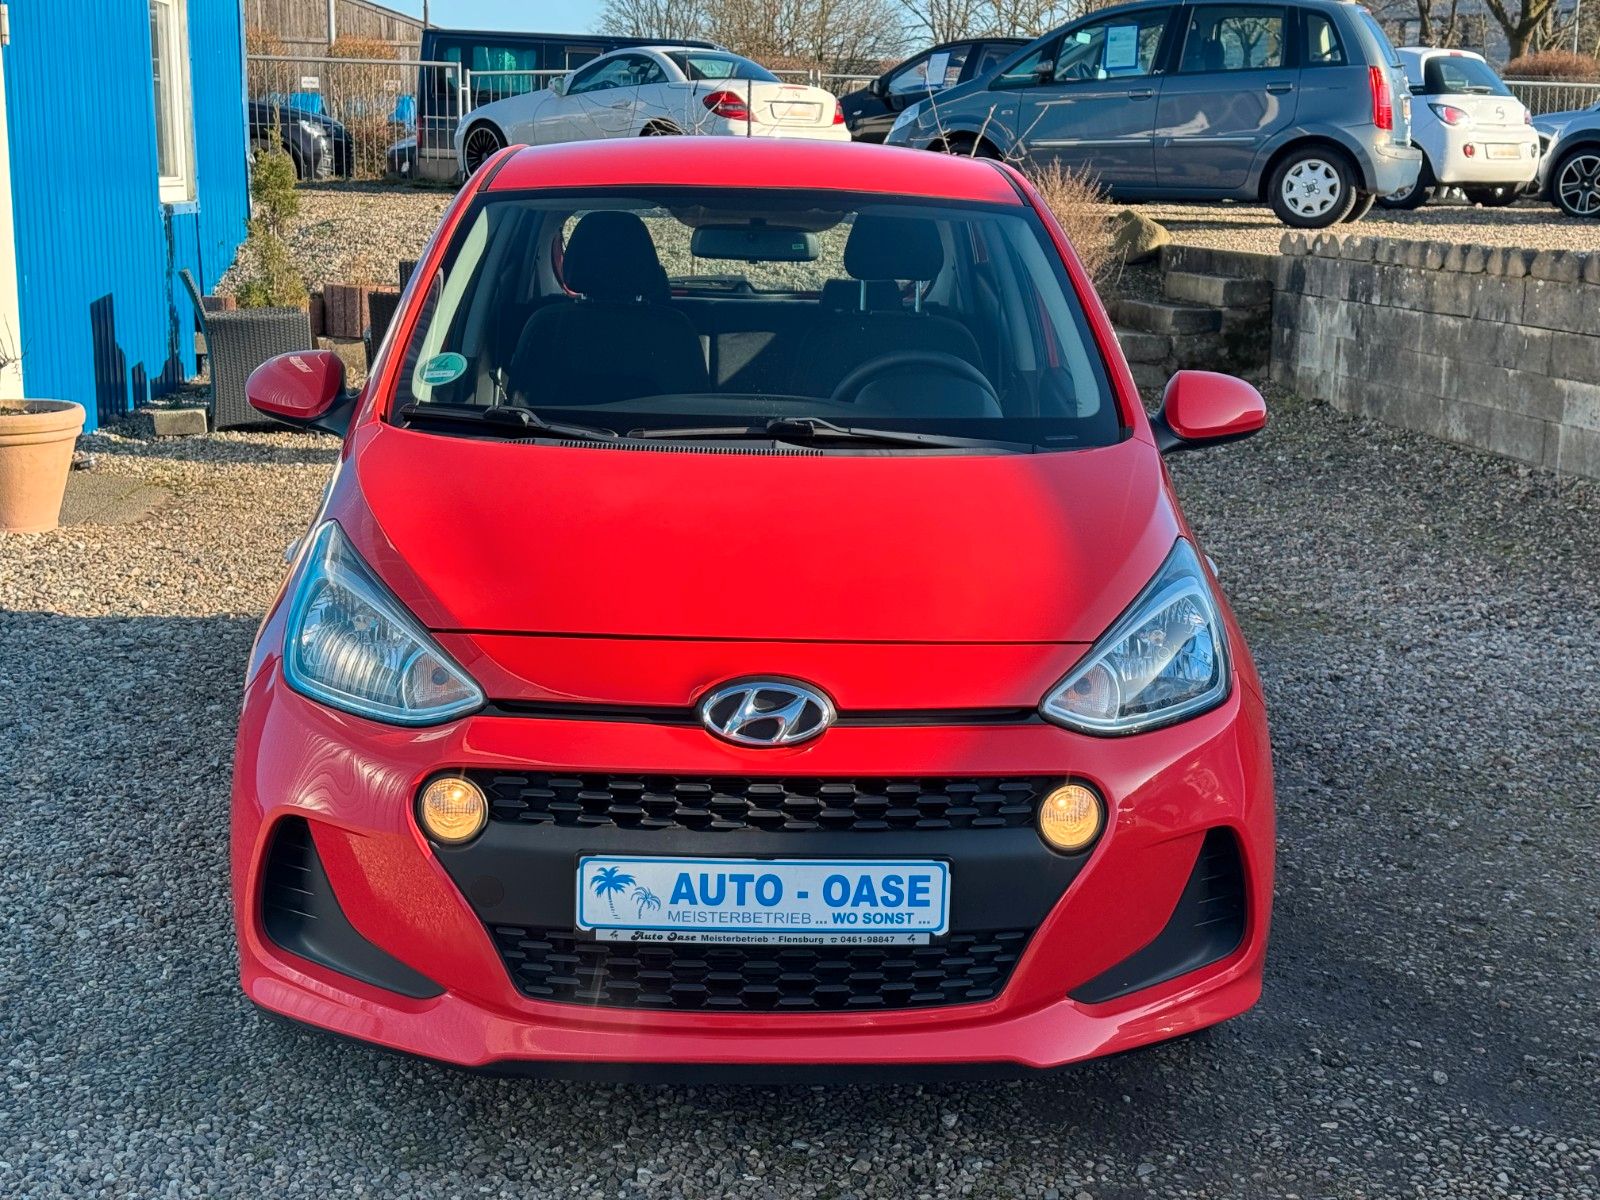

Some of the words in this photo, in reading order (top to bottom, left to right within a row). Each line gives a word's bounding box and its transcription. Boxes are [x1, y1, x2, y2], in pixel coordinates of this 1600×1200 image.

[669, 872, 783, 907] AUTO
[823, 874, 930, 907] OASE
[667, 910, 811, 924] MEISTERBETRIEB
[832, 912, 858, 924] WO
[862, 912, 914, 924] SONST
[631, 930, 663, 942] Auto
[667, 932, 697, 942] Oase
[700, 934, 769, 943] Meisterbetrieb
[778, 935, 824, 944] Flensburg
[840, 936, 895, 944] 0461-98847
